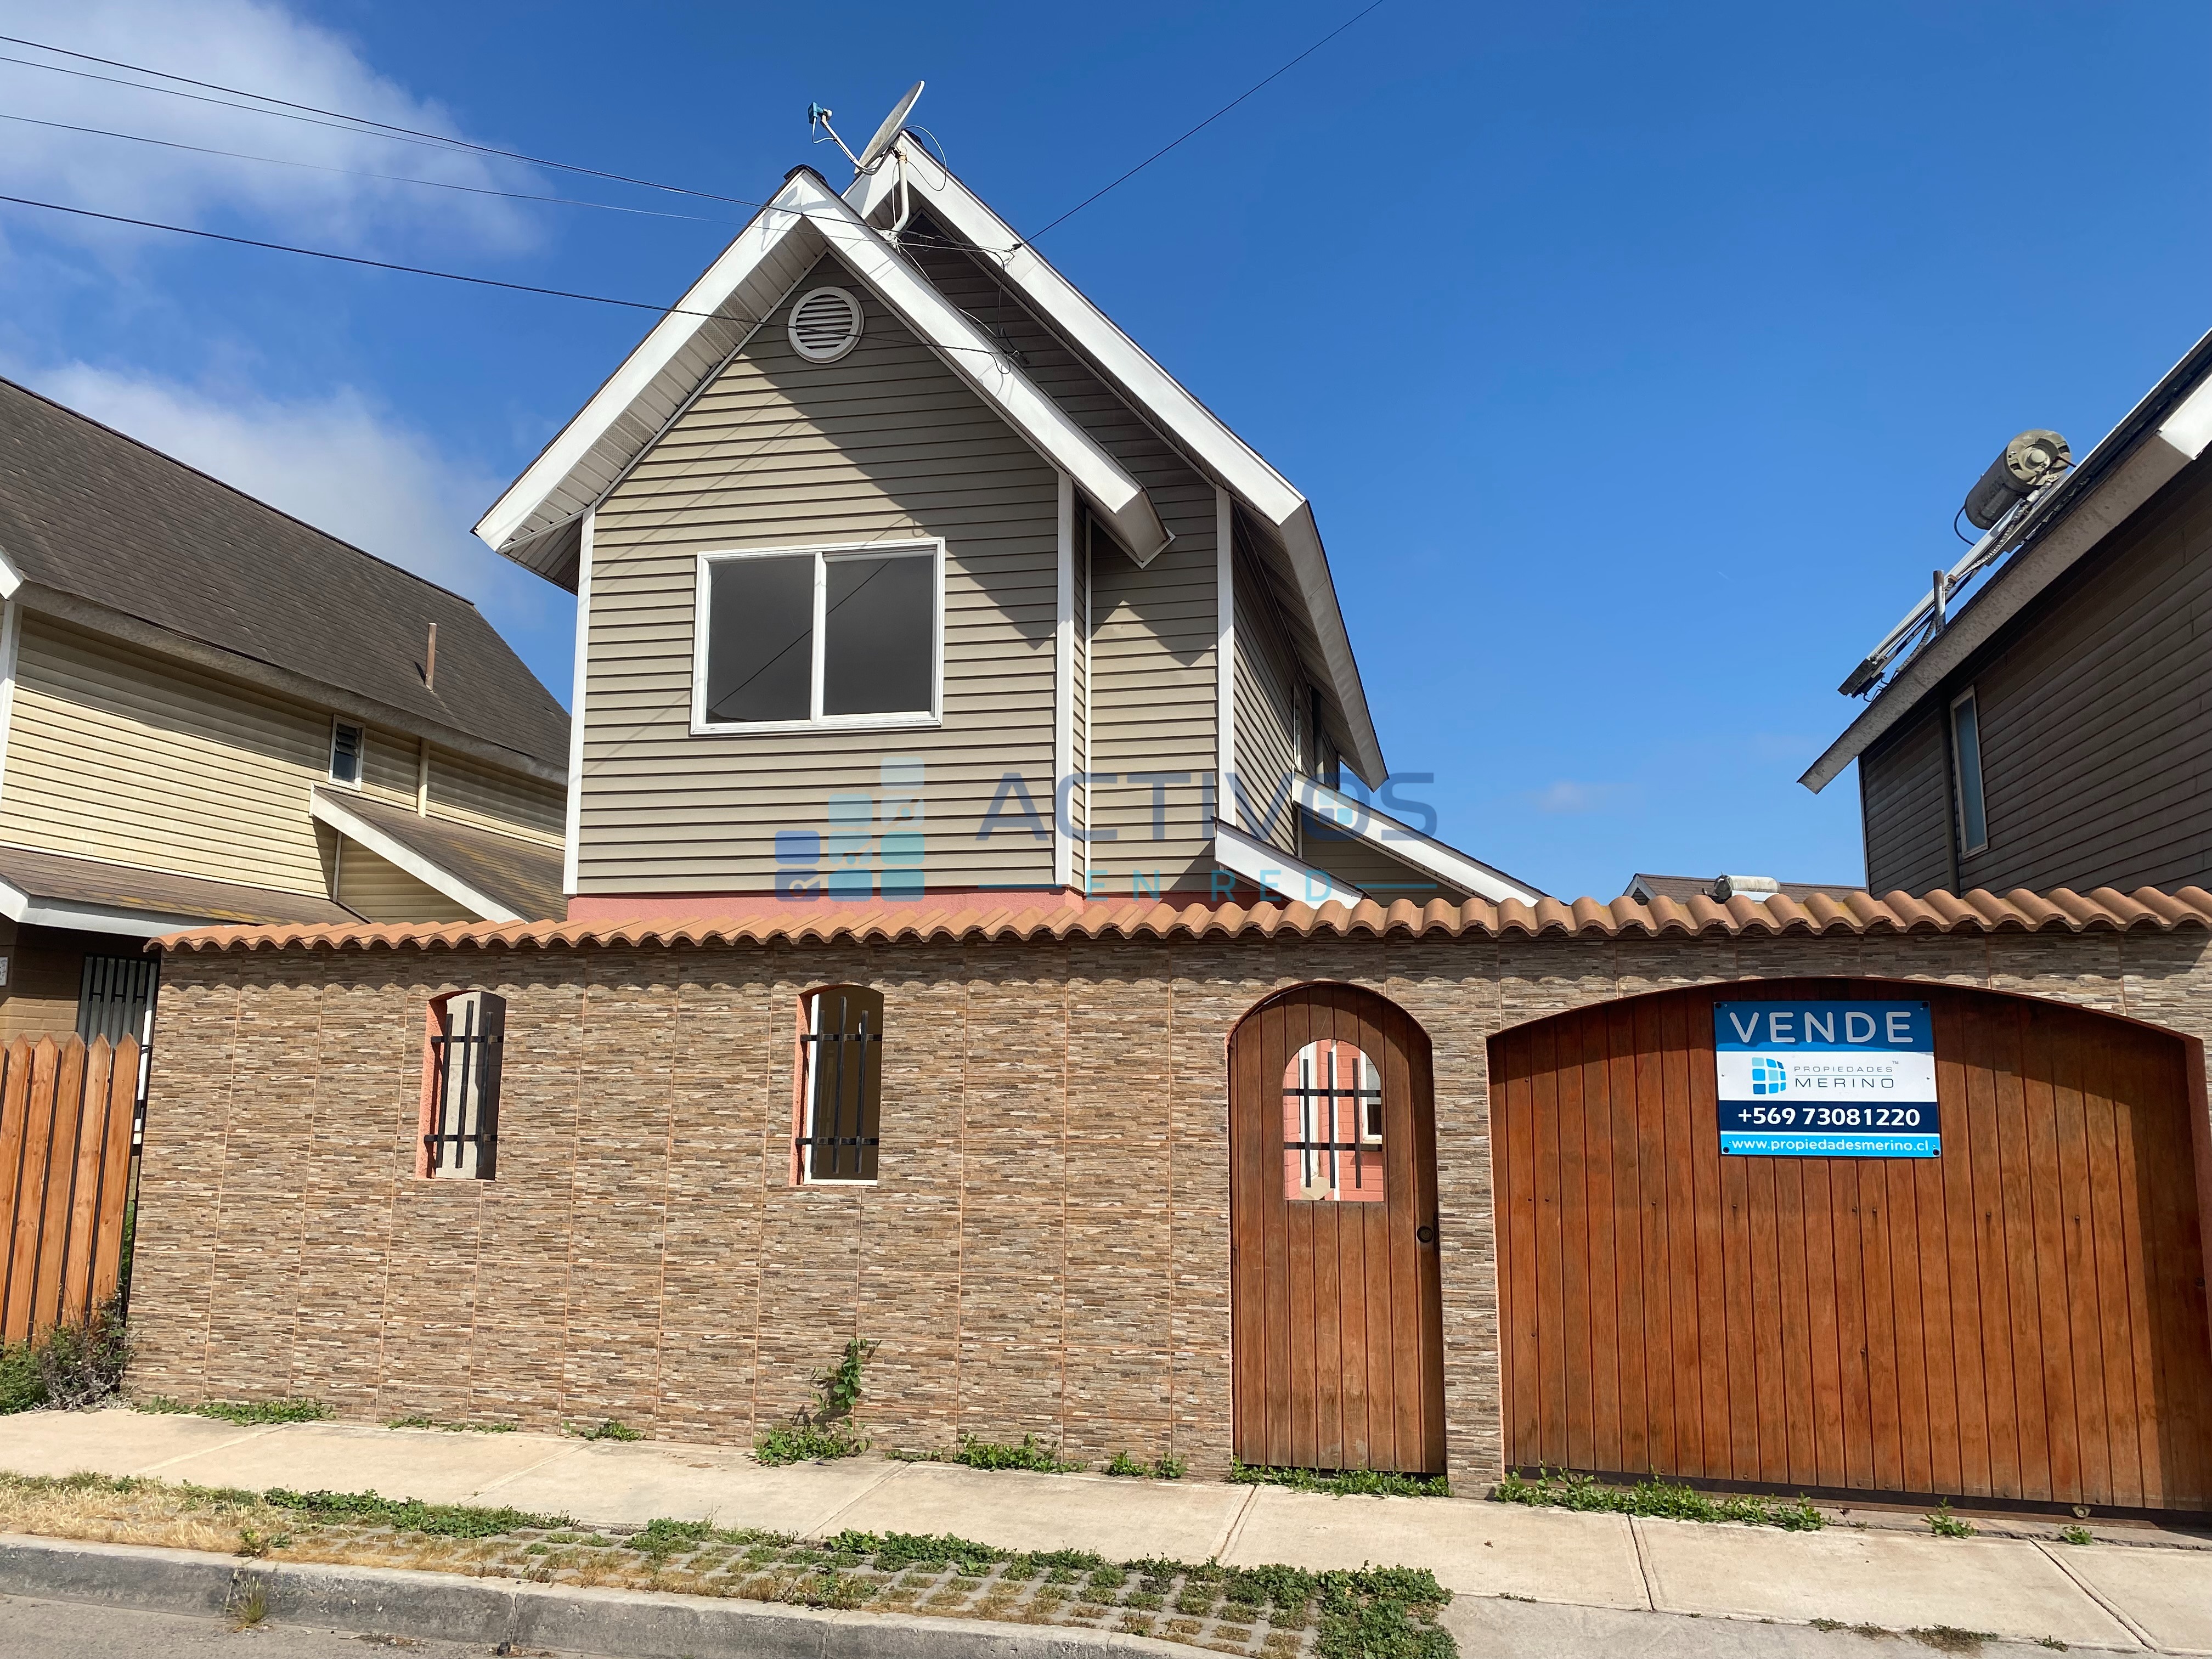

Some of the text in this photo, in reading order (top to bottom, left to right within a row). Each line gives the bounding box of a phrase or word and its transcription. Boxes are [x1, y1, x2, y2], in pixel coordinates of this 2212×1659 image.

[1729, 1012, 1914, 1043] VENDE
[1795, 1077, 1894, 1088] MERINO
[1737, 1107, 1921, 1126] +569 73081220
[1731, 1138, 1929, 1152] www.propiedadesmerino.cl
